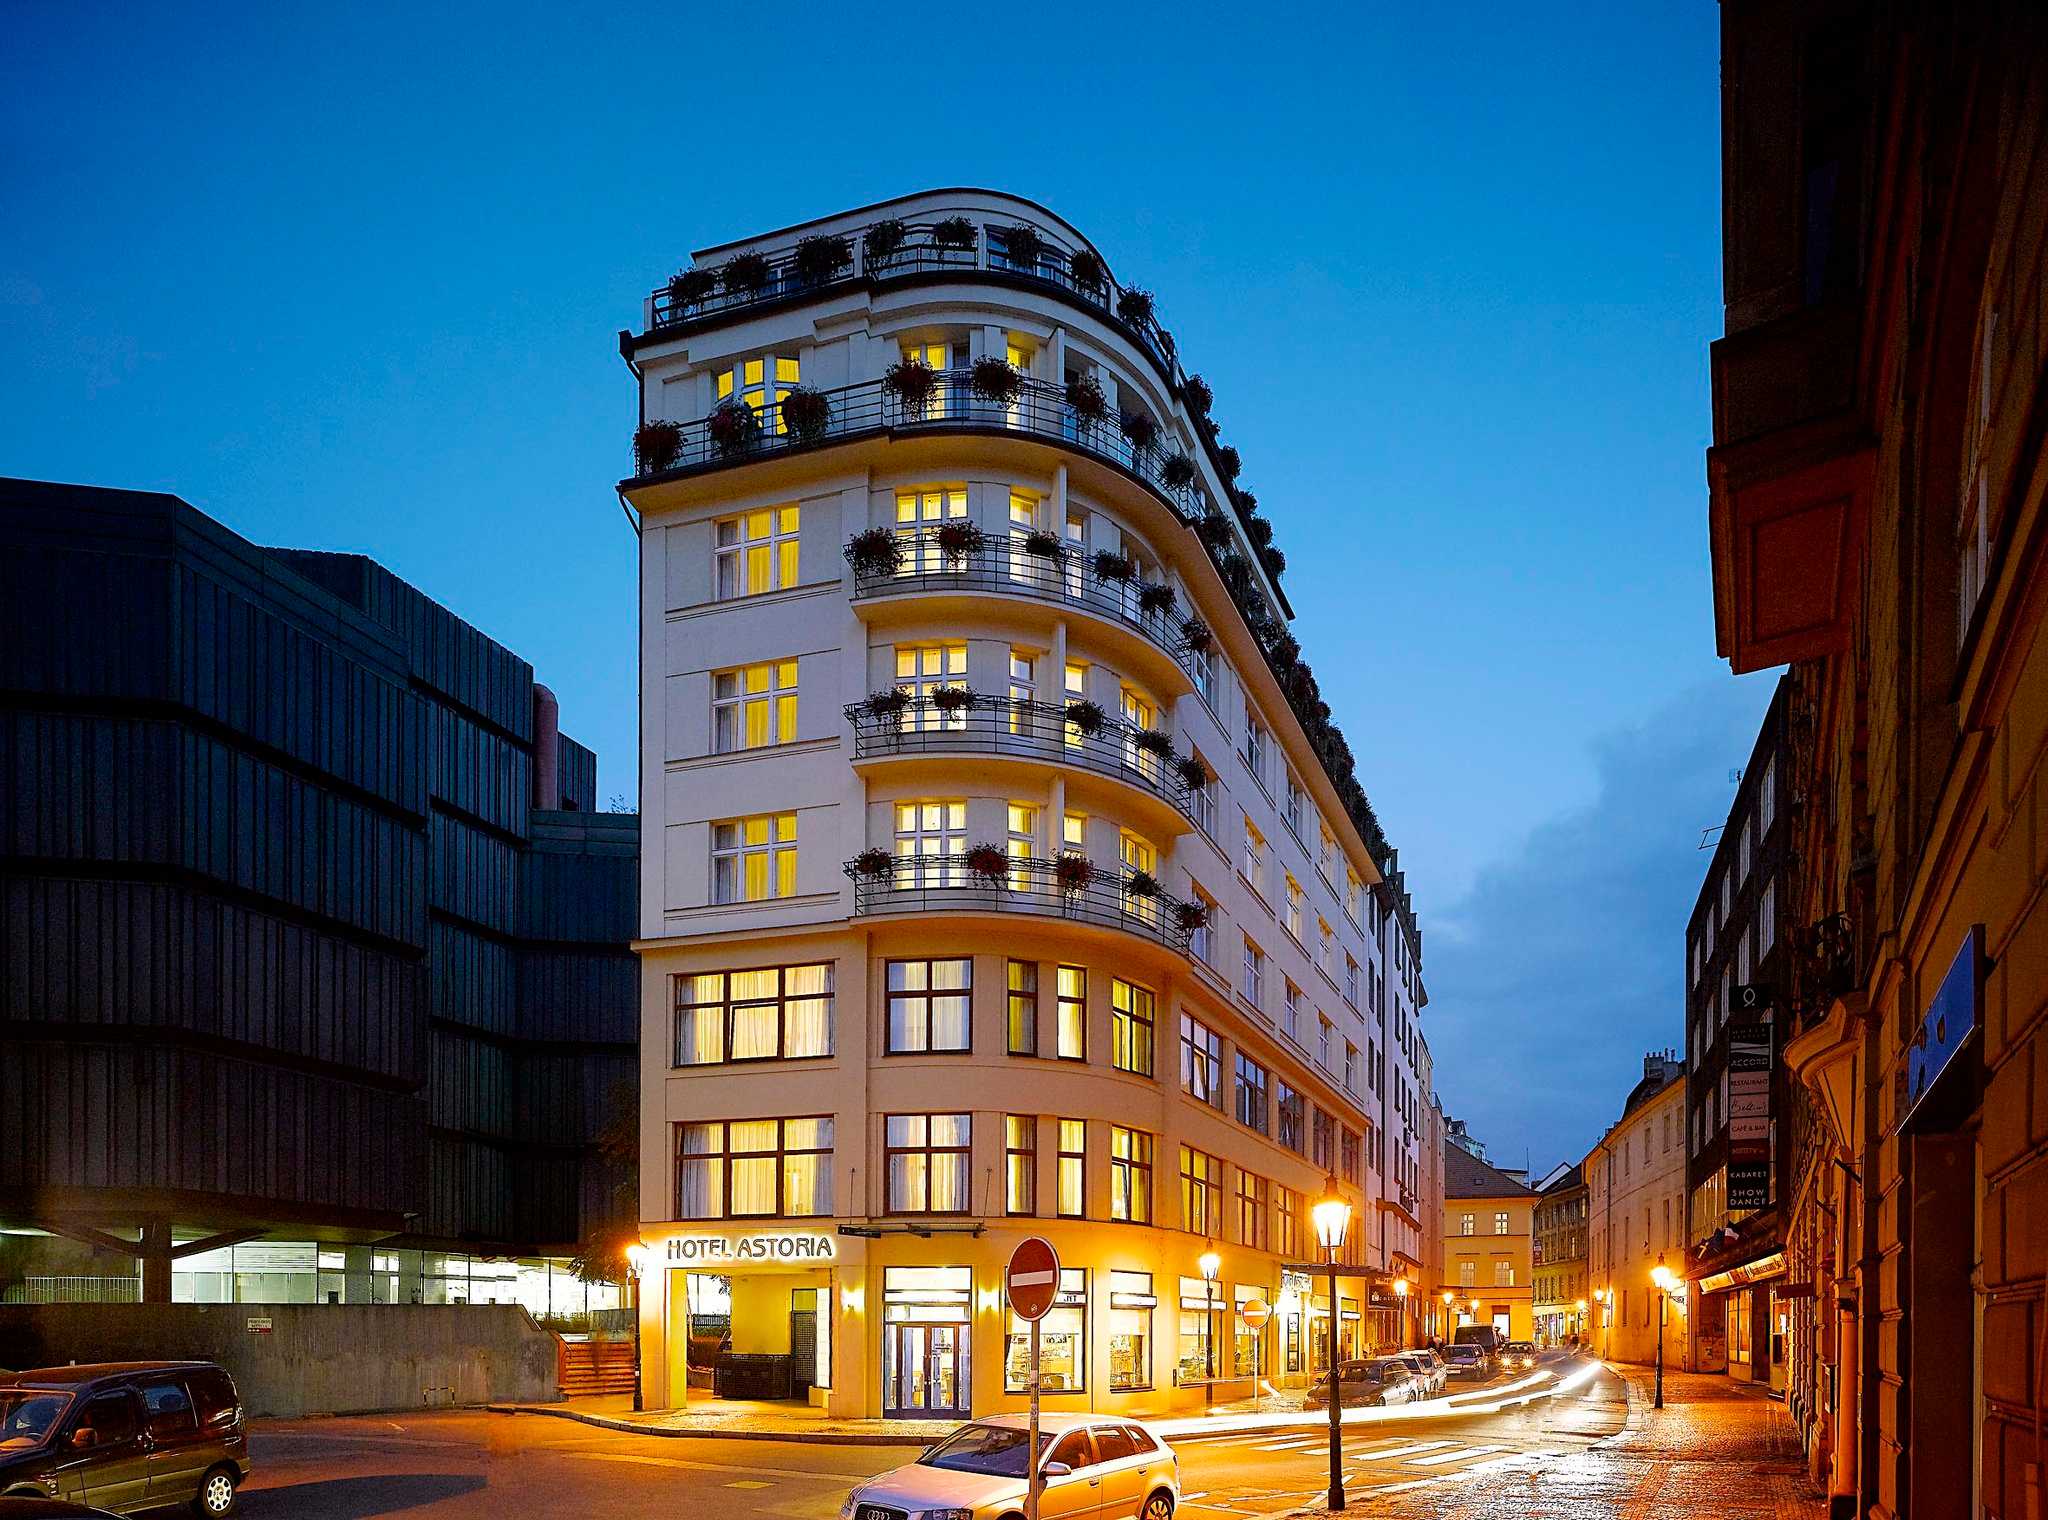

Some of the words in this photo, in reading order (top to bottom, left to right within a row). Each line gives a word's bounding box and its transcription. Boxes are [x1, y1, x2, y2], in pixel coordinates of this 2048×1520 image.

[1732, 1188, 1764, 1197] SHOW
[1730, 1197, 1767, 1206] DANCE
[667, 1239, 732, 1260] HOTEL
[737, 1236, 833, 1258] ASTORIA
